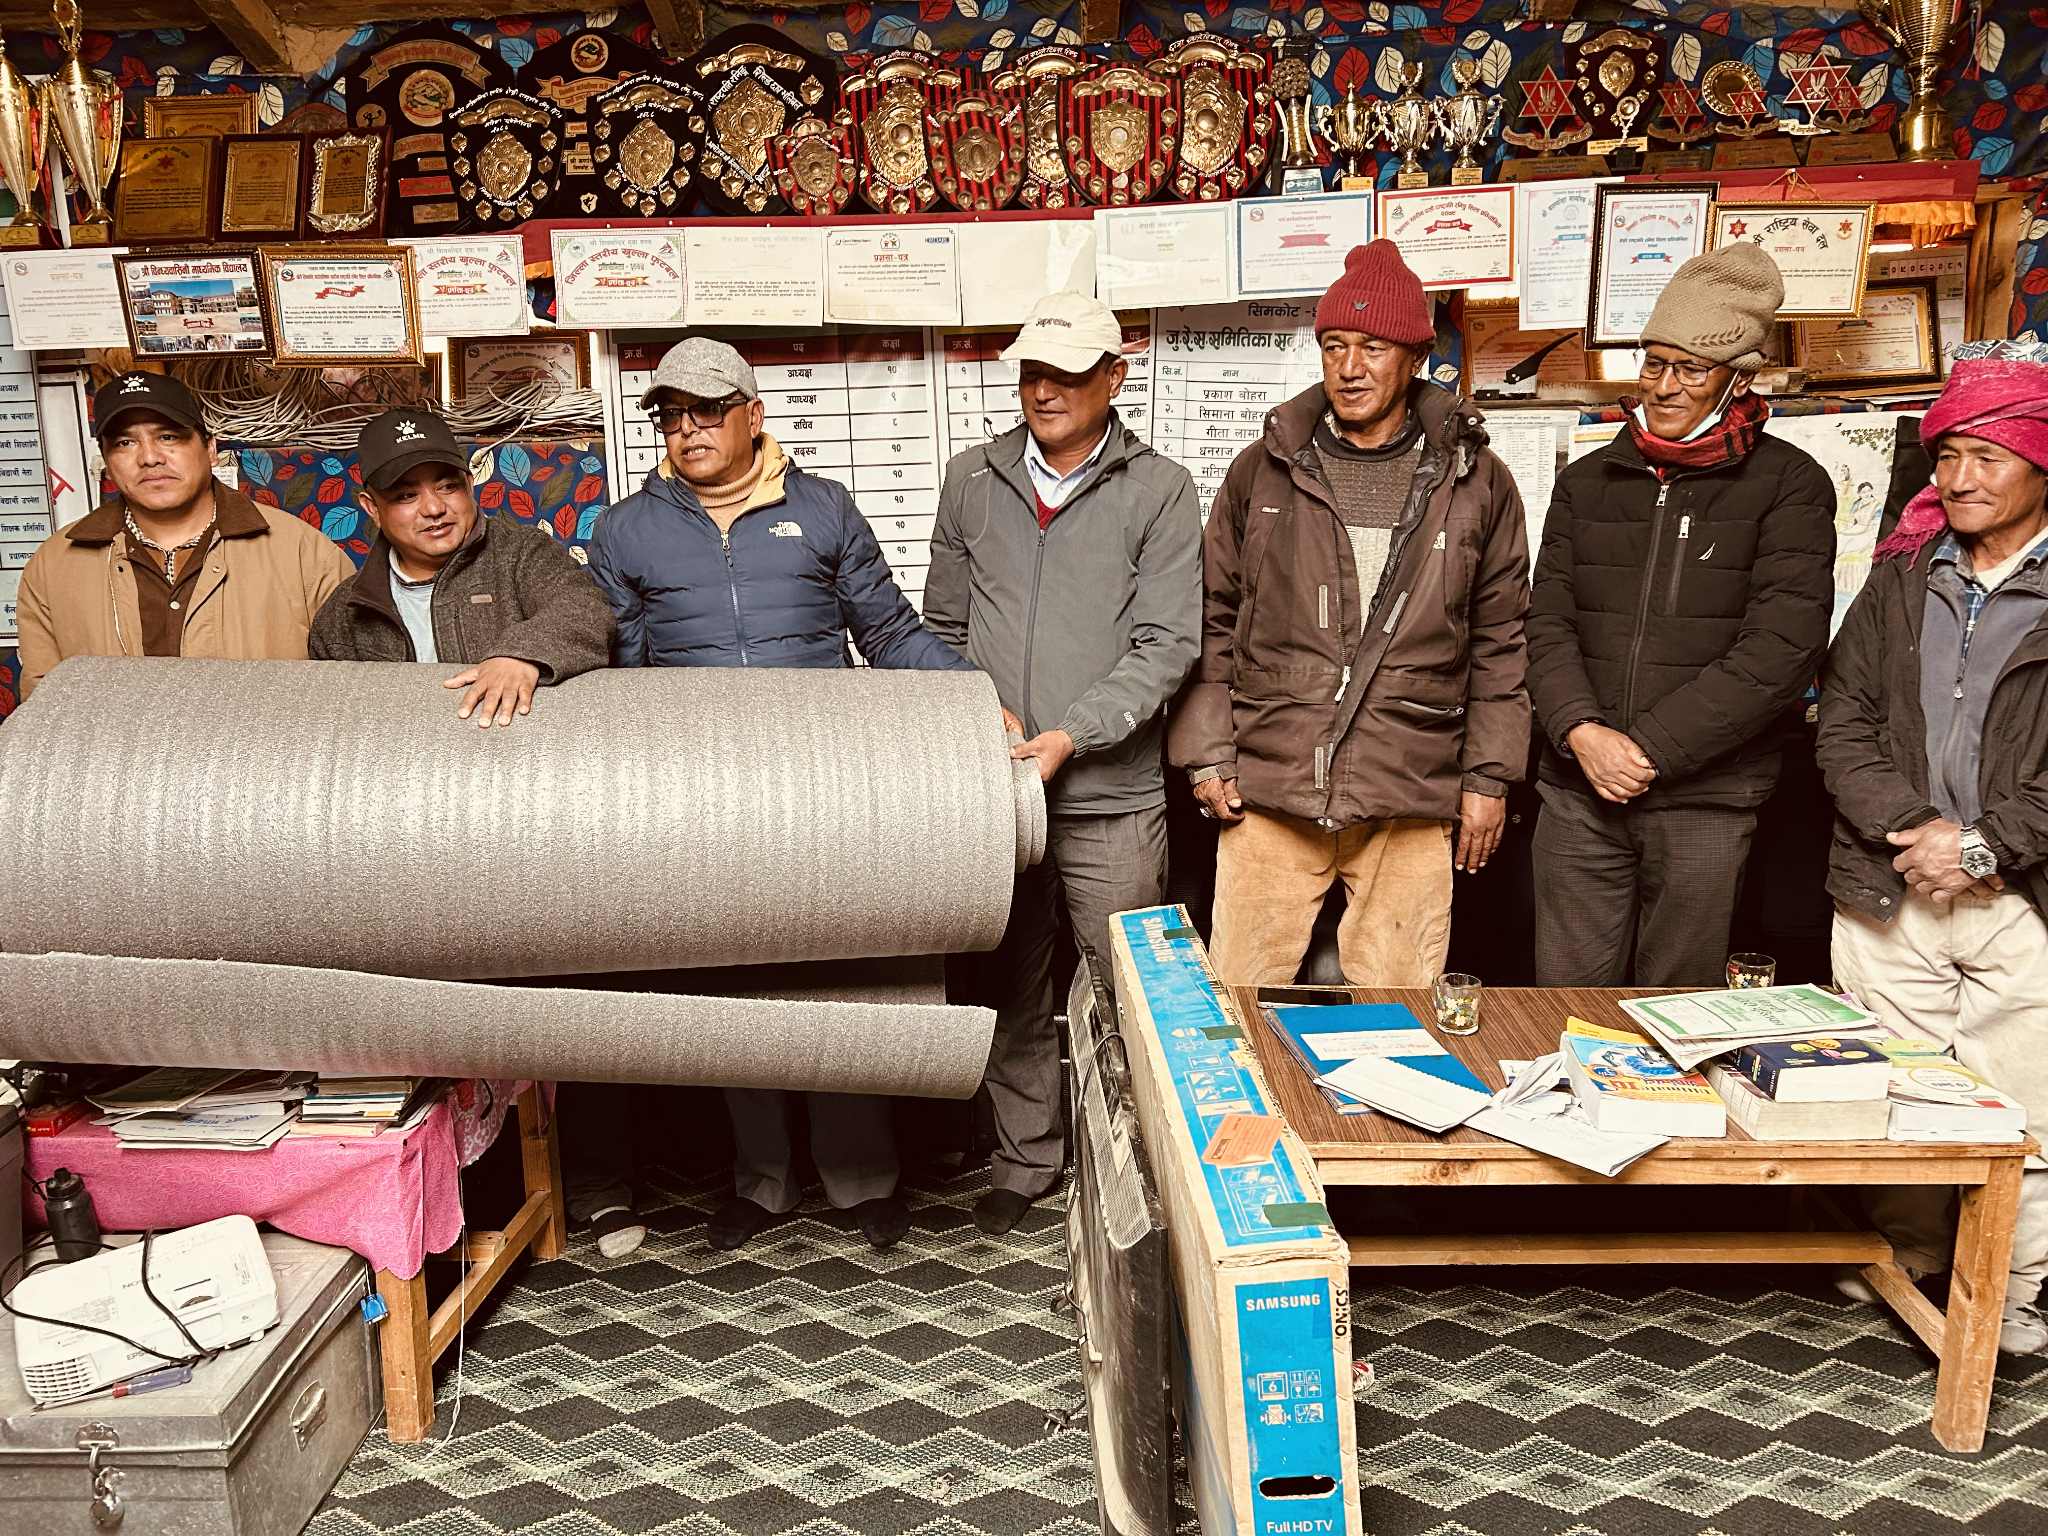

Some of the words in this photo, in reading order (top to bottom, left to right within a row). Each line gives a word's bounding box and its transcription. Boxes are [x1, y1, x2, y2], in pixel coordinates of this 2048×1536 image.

[1802, 217, 1820, 234] सेवा
[621, 247, 649, 259] खुल्ला
[459, 255, 487, 267] खुल्ला
[1248, 303, 1300, 317] सिमकोट
[787, 368, 813, 379] अध्यक्ष
[887, 366, 897, 374] १०
[120, 386, 151, 395] KELME
[1203, 389, 1234, 400] प्रकाश
[786, 395, 817, 405] उपाध्यक्ष
[1199, 406, 1236, 419] सिमाना
[1240, 408, 1267, 420] बोहर
[793, 419, 813, 430] सचिव
[1206, 425, 1230, 438] गीता
[396, 433, 427, 444] KELME
[793, 447, 817, 456] सदस्य
[891, 444, 902, 453] १०
[893, 470, 903, 478] १०
[894, 496, 904, 504] १०
[895, 521, 906, 529] १०
[897, 546, 907, 554] १०
[1141, 916, 1177, 963] SAMSUNG
[1246, 1294, 1321, 1312] SAMSUNG
[1335, 1289, 1348, 1340] ONICS
[1266, 1522, 1291, 1534] Full
[1293, 1521, 1313, 1532] HD
[1315, 1520, 1333, 1531] TV
